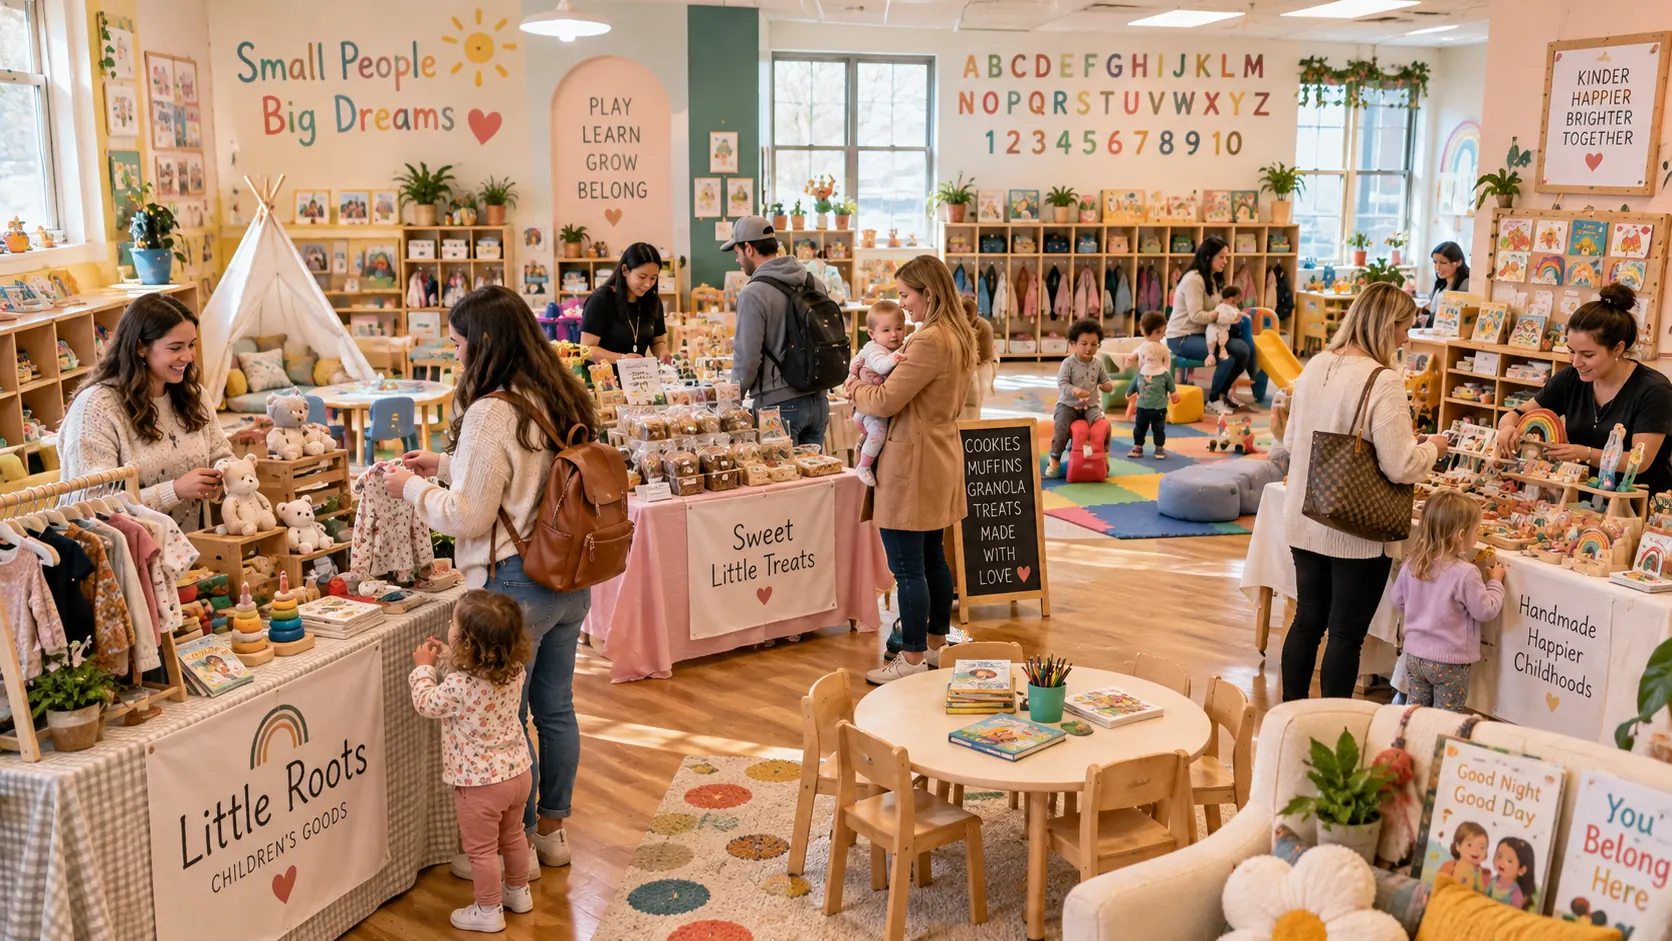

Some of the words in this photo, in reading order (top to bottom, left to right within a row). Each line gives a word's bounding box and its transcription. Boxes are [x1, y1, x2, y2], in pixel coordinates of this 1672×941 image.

[237, 41, 326, 83] Small
[340, 41, 437, 91] People
[1577, 68, 1630, 86] KINDER
[588, 97, 633, 117] PLAY
[1571, 89, 1632, 107] HAPPIER
[262, 95, 316, 147] Big
[334, 94, 455, 134] Dreams
[1566, 110, 1633, 126] BRIGHTER
[581, 125, 642, 145] LEARN
[1563, 130, 1634, 146] TOGETHER
[585, 152, 638, 172] GROW
[577, 181, 648, 200] BELONG
[964, 436, 1021, 453] COOKIES
[967, 458, 1023, 476] MUFFINS
[967, 480, 1026, 497] GRANOLA
[973, 501, 1022, 518] TREATS
[732, 518, 794, 551] Sweet
[980, 524, 1016, 542] MADE
[983, 546, 1016, 563] WITH
[711, 558, 758, 588] Little
[763, 549, 815, 577] Treats
[979, 567, 1013, 585] LOVE
[1518, 594, 1597, 639] Handmade
[1527, 627, 1584, 664] Happier
[1513, 651, 1593, 699] Childhoods
[1457, 763, 1496, 787] Good
[1500, 774, 1542, 803] Night
[179, 783, 272, 871] Little
[286, 738, 368, 812] Roots
[1454, 785, 1497, 813] Good
[1502, 799, 1537, 829] Day
[1606, 792, 1655, 837] You
[302, 801, 348, 841] GOODS
[1583, 823, 1671, 890] Belong
[1591, 865, 1649, 913] Here
